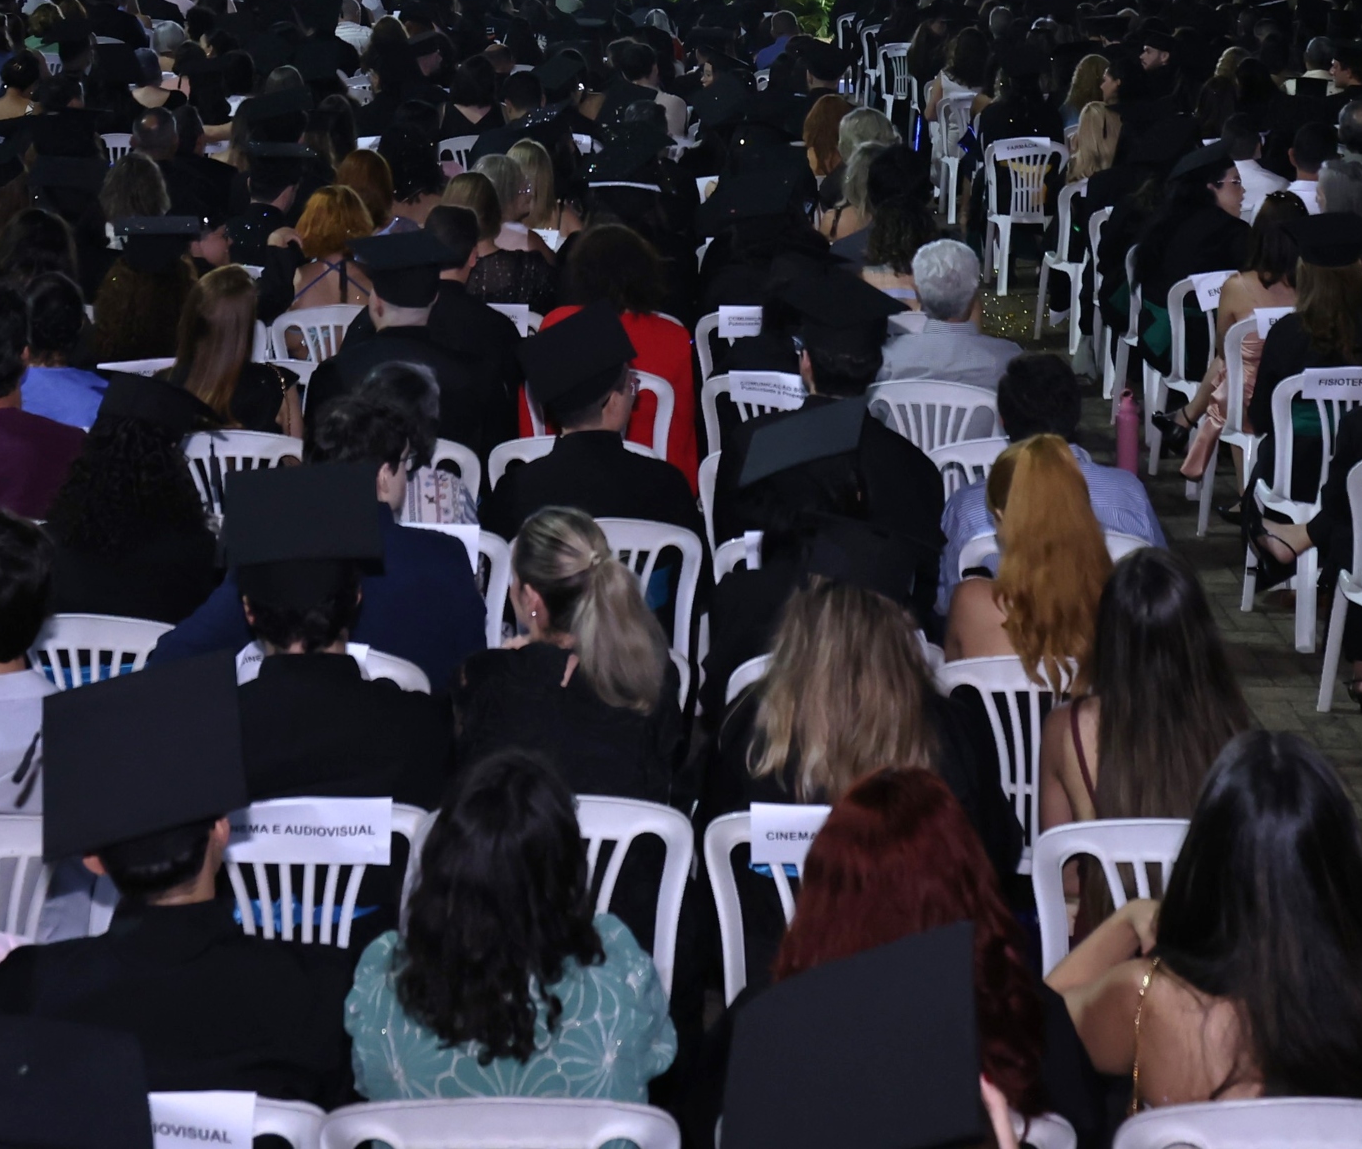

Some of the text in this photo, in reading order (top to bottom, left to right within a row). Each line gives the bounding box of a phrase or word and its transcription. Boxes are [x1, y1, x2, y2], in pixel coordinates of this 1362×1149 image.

[272, 825, 281, 834] E
[284, 824, 376, 838] AUDIOVISUAL
[153, 1122, 232, 1145] IOVISUAL
